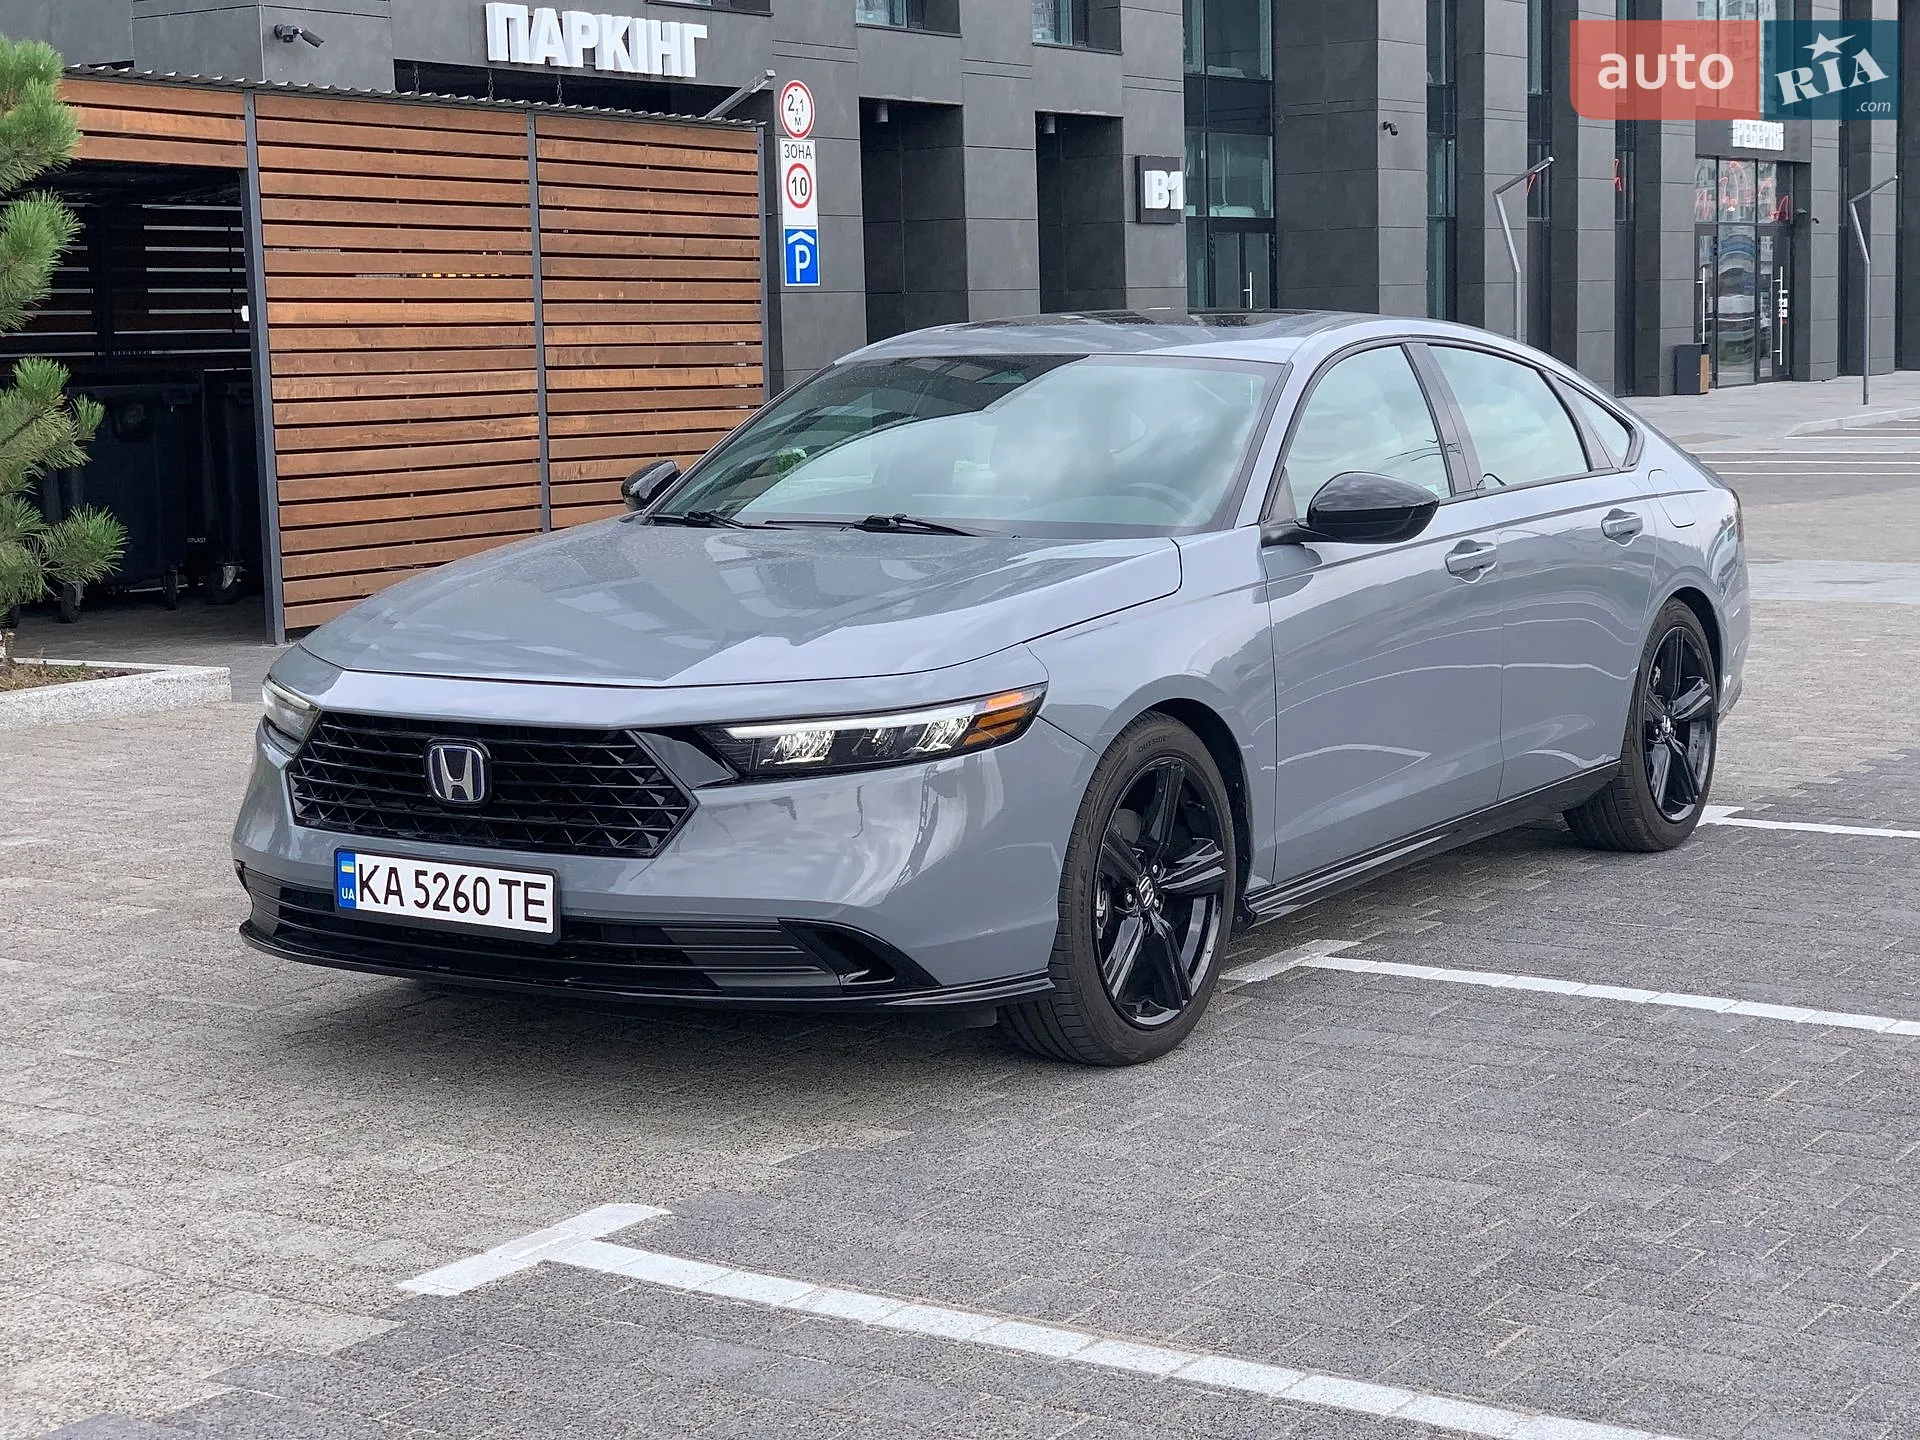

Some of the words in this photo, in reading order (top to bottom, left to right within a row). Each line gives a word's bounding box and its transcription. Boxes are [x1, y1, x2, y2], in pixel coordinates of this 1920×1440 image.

[485, 2, 708, 78] ПАРКІНГ
[787, 94, 804, 115] 2,1
[783, 143, 813, 160] ЗОНА
[791, 176, 808, 197] 10
[794, 244, 811, 283] P
[341, 887, 355, 901] UA
[358, 863, 405, 907] KA
[413, 869, 490, 916] 5260
[498, 878, 548, 924] TE
